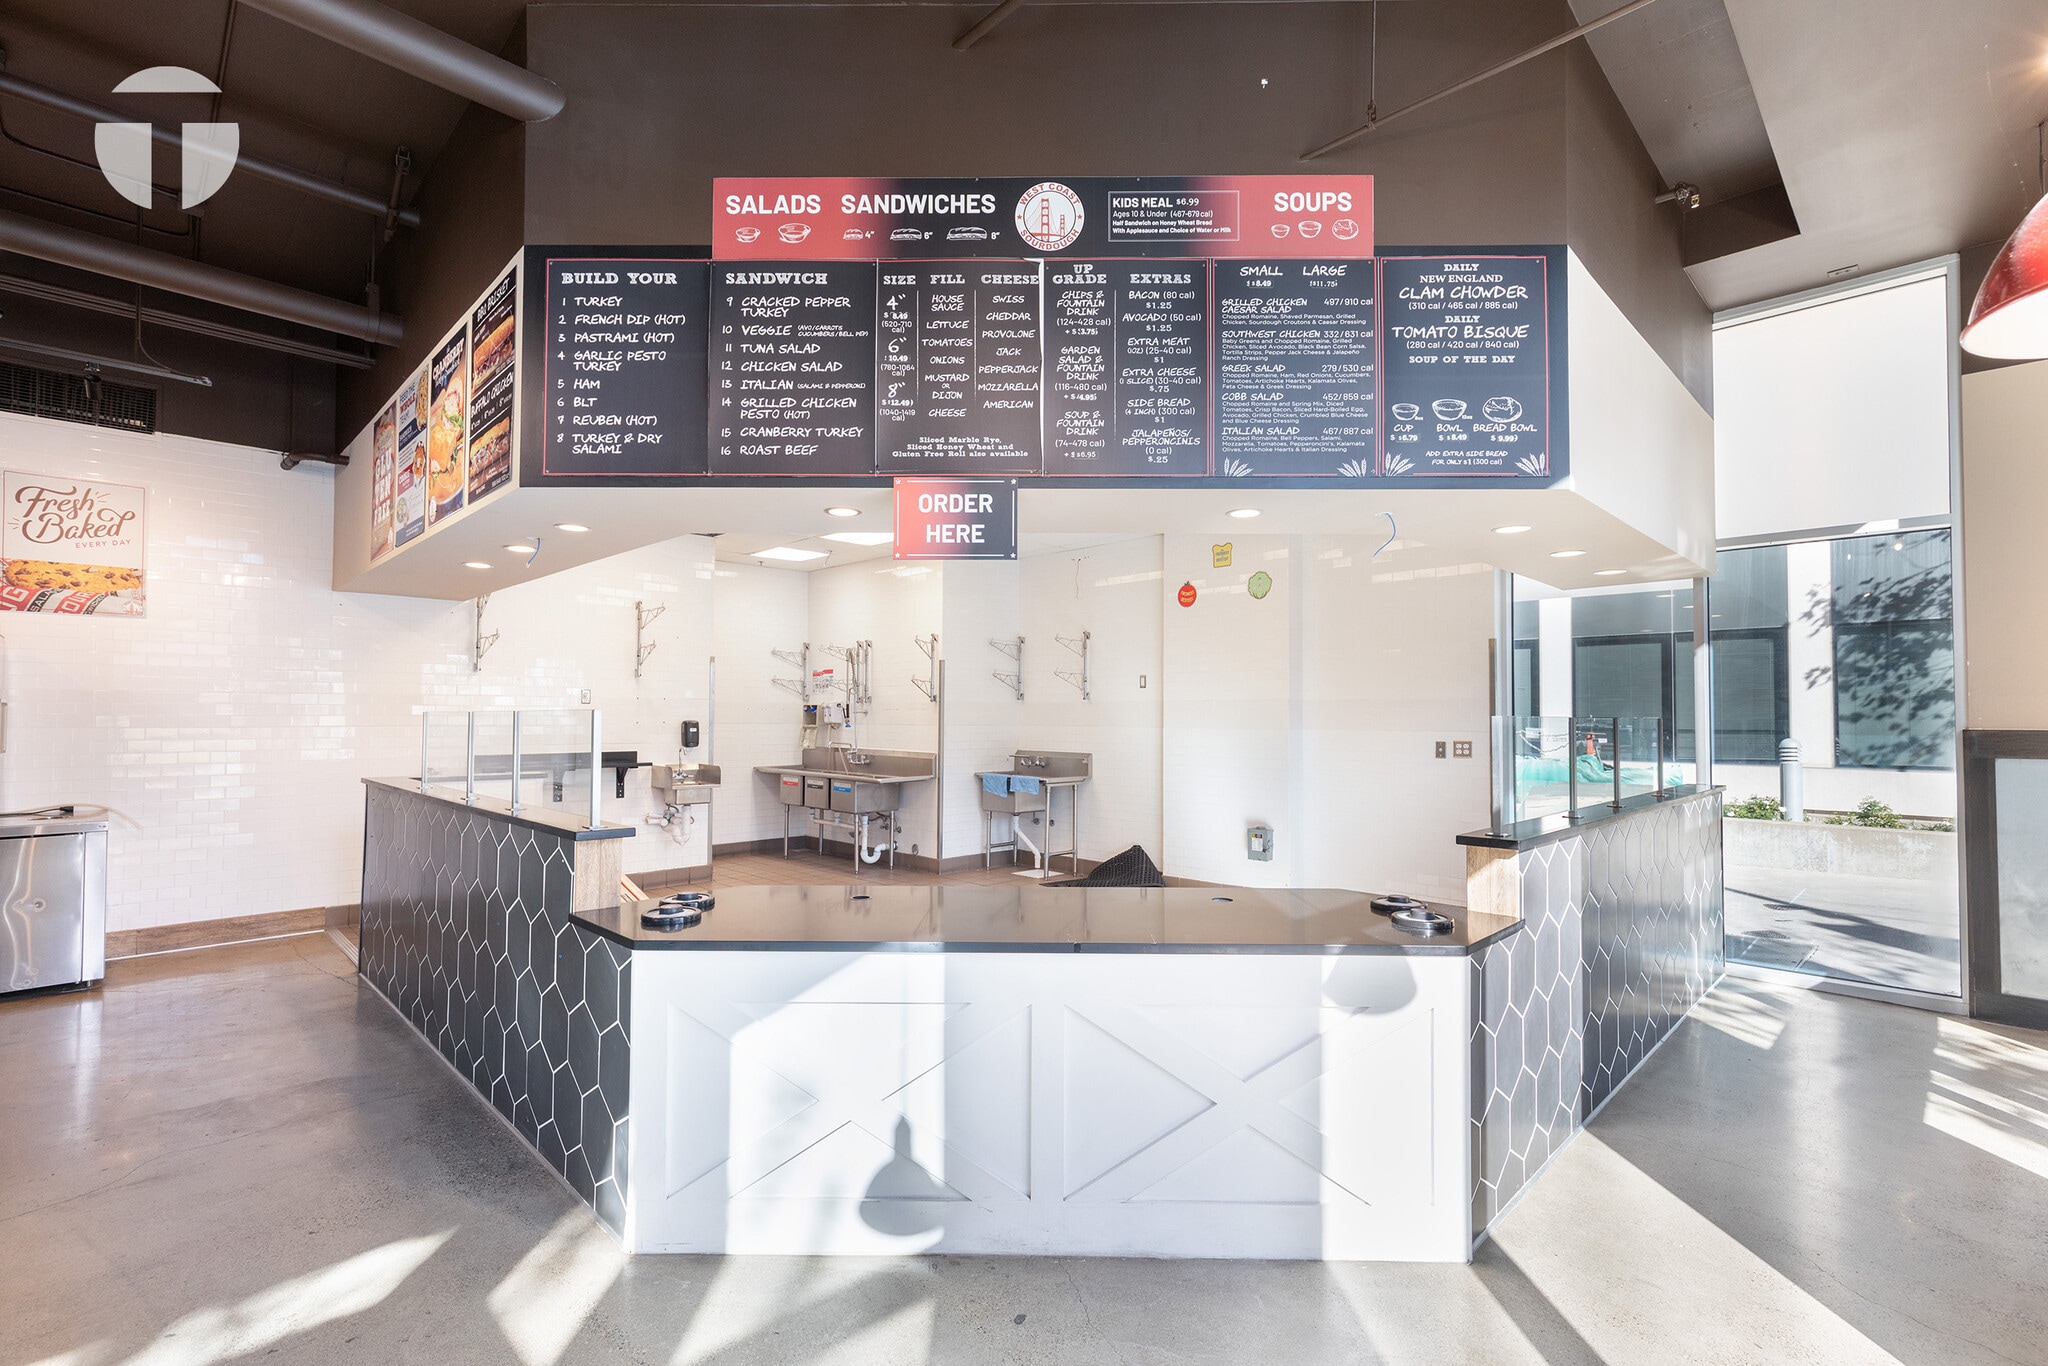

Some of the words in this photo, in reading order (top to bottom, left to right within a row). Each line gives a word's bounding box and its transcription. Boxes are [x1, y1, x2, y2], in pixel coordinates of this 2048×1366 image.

[1020, 184, 1045, 206] WEST
[1048, 183, 1080, 205] COAST
[725, 194, 821, 215] SALADS
[841, 194, 996, 214] SANDWICHES
[1112, 198, 1139, 208] KIDS
[1141, 197, 1173, 208] MEAL
[1176, 198, 1200, 206] $6.99
[1273, 192, 1352, 213] SOUPS
[1113, 211, 1130, 219] Ages
[1146, 210, 1167, 218] Under
[1021, 229, 1079, 250] SOURDOUGH
[1073, 264, 1094, 274] UP
[1240, 265, 1284, 276] SMALL
[1303, 265, 1348, 276] LARGE
[1444, 264, 1479, 272] DAILY
[561, 273, 619, 285] BUILD
[628, 273, 678, 285] YOUR
[726, 273, 828, 285] SANDWICH
[883, 275, 916, 285] SIZE
[930, 275, 966, 284] FILL
[981, 275, 1039, 285] CHEESE
[1052, 274, 1107, 284] GRADE
[1130, 274, 1192, 284] EXTRAS
[1419, 275, 1446, 283] NEW
[1448, 275, 1503, 283] ENGLAND
[1129, 291, 1160, 299] BACON
[1399, 286, 1445, 299] CLAM
[1450, 285, 1528, 299] CHOWDER
[574, 296, 623, 307] TURKEY
[726, 297, 733, 307] 9
[741, 296, 800, 307] CRACKED
[805, 297, 851, 308] PEPPER
[931, 294, 964, 303] HOUSE
[992, 295, 1025, 304] SWISS
[1222, 298, 1263, 306] GRILLED
[1266, 298, 1308, 306] CHICKEN
[931, 303, 964, 311] SAUCE
[1057, 300, 1105, 308] FOUNTAIN
[740, 307, 788, 318] TURKEY
[1066, 308, 1100, 316] DRINK
[1221, 306, 1258, 314] CAESAR
[1260, 306, 1292, 314] SALAD
[559, 315, 566, 325] 2
[574, 314, 623, 325] FRENCH
[626, 313, 651, 325] DIP
[654, 313, 686, 326] (HOT)
[986, 312, 1032, 321] CHEDDAR
[1122, 313, 1167, 322] AVOCADO
[722, 325, 732, 335] 10
[741, 324, 791, 336] VEGGIE
[926, 321, 970, 329] LETTUCE
[982, 330, 1036, 338] PROVOLONE
[1391, 326, 1458, 338] TOMATO
[1463, 324, 1530, 338] BISQUE
[558, 333, 566, 343] 3
[574, 332, 639, 343] PASTRAMI
[643, 332, 675, 344] (HOT)
[922, 339, 973, 347] TOMATOES
[725, 344, 732, 352] 11
[741, 343, 776, 354] TUNA
[778, 343, 820, 354] SALAD
[996, 348, 1022, 356] JACK
[557, 351, 565, 361] 4
[573, 350, 623, 362] GARLIC
[626, 350, 666, 361] PESTO
[930, 356, 965, 364] ONIONS
[1409, 355, 1439, 364] SOUP
[1443, 355, 1459, 364] OF
[1464, 355, 1487, 364] THE
[1492, 355, 1516, 364] DAY
[573, 361, 622, 372] TURKEY
[722, 361, 732, 370] 12
[741, 361, 797, 372] CHICKEN
[801, 361, 843, 372] SALAD
[979, 365, 1039, 374] PEPPERJACK
[925, 374, 970, 382] MUSTARD
[557, 379, 565, 389] 5
[573, 378, 601, 390] HAM
[722, 379, 732, 389] 13
[741, 379, 794, 390] ITALIAN
[978, 383, 1039, 391] MOZZARELLA
[932, 391, 963, 400] DIJON
[1221, 392, 1247, 401] COBB
[1250, 392, 1284, 400] SALAD
[557, 398, 565, 407] 6
[573, 397, 598, 408] BLT
[721, 398, 732, 407] 14
[740, 398, 796, 408] GRILLED
[801, 398, 857, 409] CHICKEN
[983, 400, 1034, 409] AMERICAN
[740, 409, 780, 420] PESTO
[783, 410, 810, 420] (HOT)
[928, 408, 967, 417] CHEESE
[557, 415, 565, 425] 7
[573, 414, 622, 426] REUBEN
[625, 415, 658, 426] (HOT)
[721, 428, 731, 437] 15
[740, 427, 812, 438] CRANBERRY
[815, 427, 864, 438] TURKEY
[1393, 424, 1414, 433] CUP
[1436, 424, 1463, 432] BOWL
[1473, 424, 1507, 432] BREAD
[1510, 424, 1538, 432] BOWL
[557, 433, 564, 443] 8
[571, 433, 620, 444] TURKEY
[624, 433, 635, 444] &
[637, 433, 663, 444] DRY
[1122, 437, 1201, 446] PEPPERONCINIS
[572, 443, 622, 455] SALAMI
[721, 446, 731, 456] 16
[740, 445, 781, 456] ROAST
[785, 445, 818, 456] BEEF
[15, 486, 95, 520] Fresh
[918, 494, 993, 513] ORDER
[22, 508, 136, 544] Baked
[926, 524, 985, 543] HERE
[76, 541, 107, 549] EVERY
